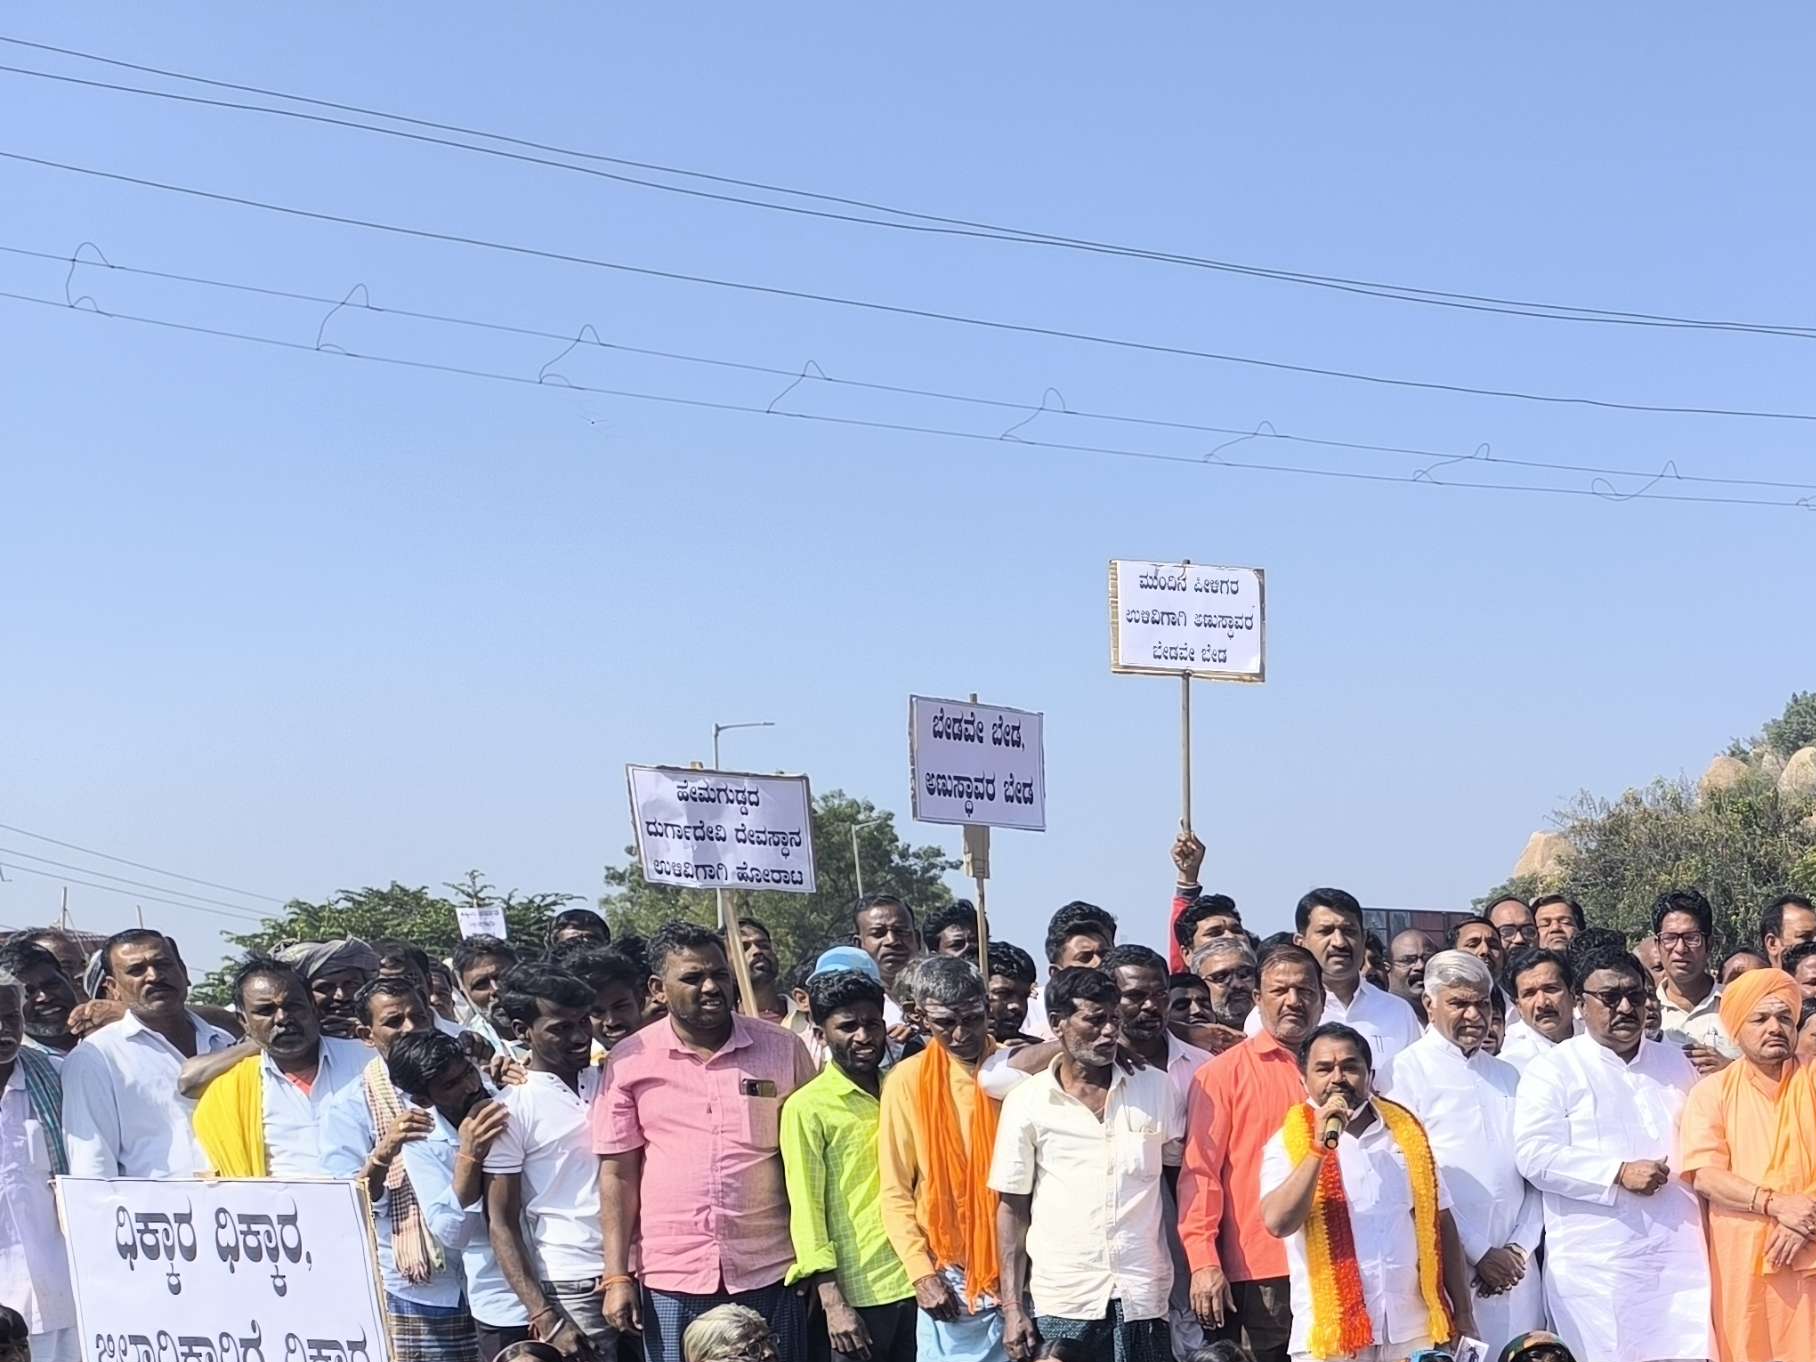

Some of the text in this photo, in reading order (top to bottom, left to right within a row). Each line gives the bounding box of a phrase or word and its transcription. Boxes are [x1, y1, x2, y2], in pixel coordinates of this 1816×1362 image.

[1139, 570, 1187, 592] ಮುಂದಿನ
[1126, 609, 1254, 640] ಉಳಿವಿಗಾಗಿ ಅಣುಸ್ಥಾವರ
[1152, 641, 1227, 663] ಬೇಡವೇ ಬೇಡ
[932, 707, 984, 744] ಬೇಡವೇ
[676, 780, 760, 815] ಹೇಮಗುಡ್ಡದ
[925, 771, 1034, 818] ಅಣುಸ್ಥಾವರ ಬೇಡ
[645, 817, 802, 859] ದುರ್ಗಾದೇವಿ ದೇವಸ್ಥಾನ
[653, 859, 804, 885] ಉಳಿವಿಗಾಗಿ ಹೋರಾಟ
[115, 1197, 313, 1297] ಧಿಕ್ಕಾರ ಧಿಕ್ಕಾರ,
